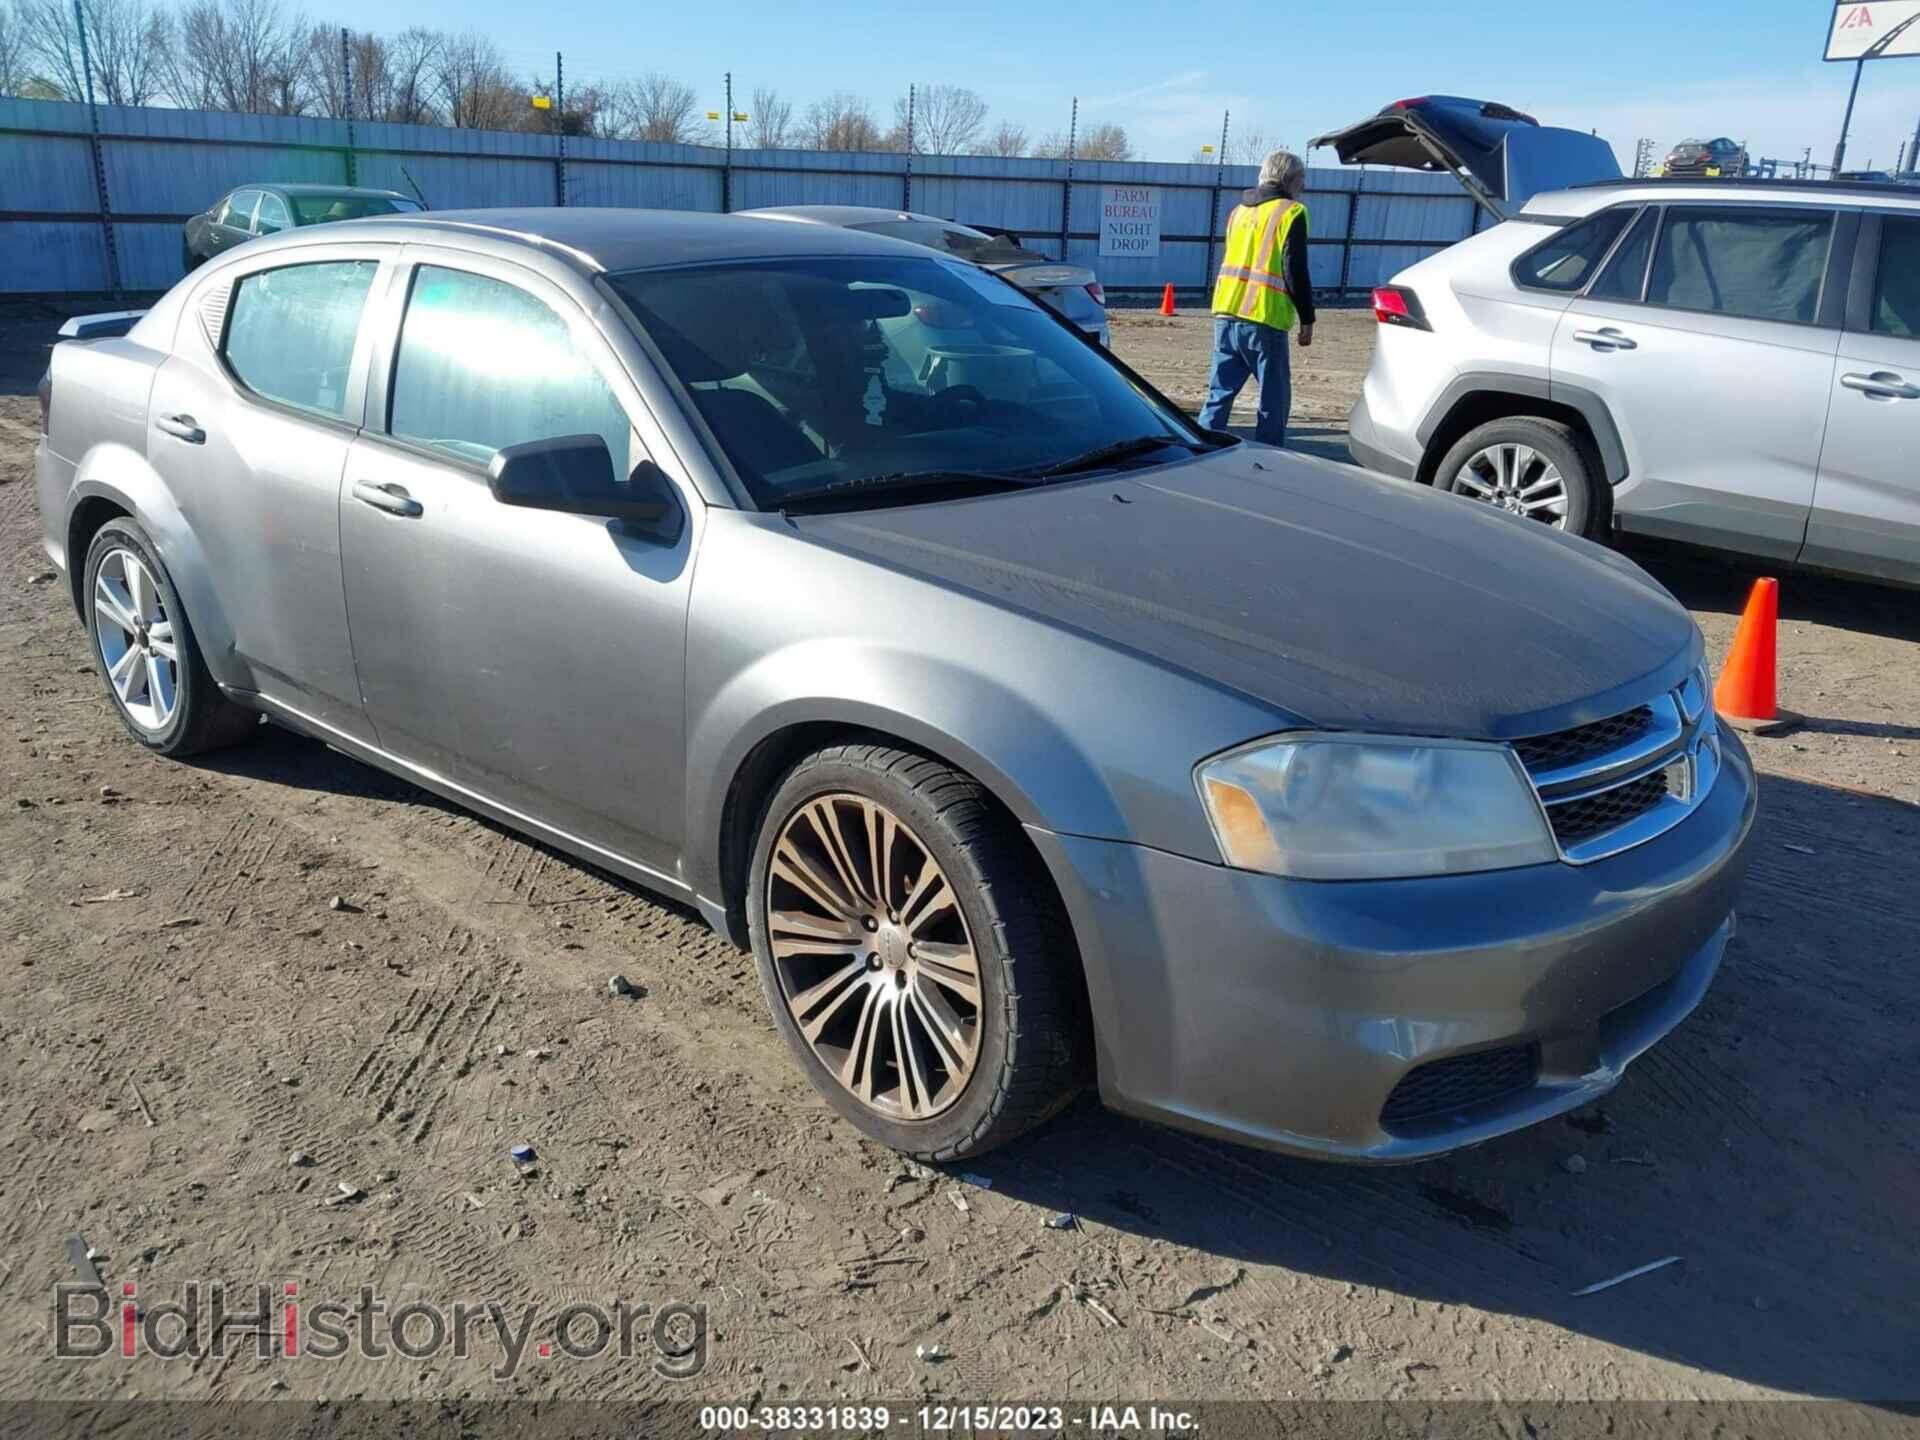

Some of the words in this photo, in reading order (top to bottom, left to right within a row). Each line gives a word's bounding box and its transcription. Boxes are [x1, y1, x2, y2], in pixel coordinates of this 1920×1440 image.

[1113, 189, 1150, 202] FARM
[1104, 204, 1158, 218] BUREAU
[1108, 222, 1153, 235] NIGHT
[1111, 238, 1149, 250] DROP
